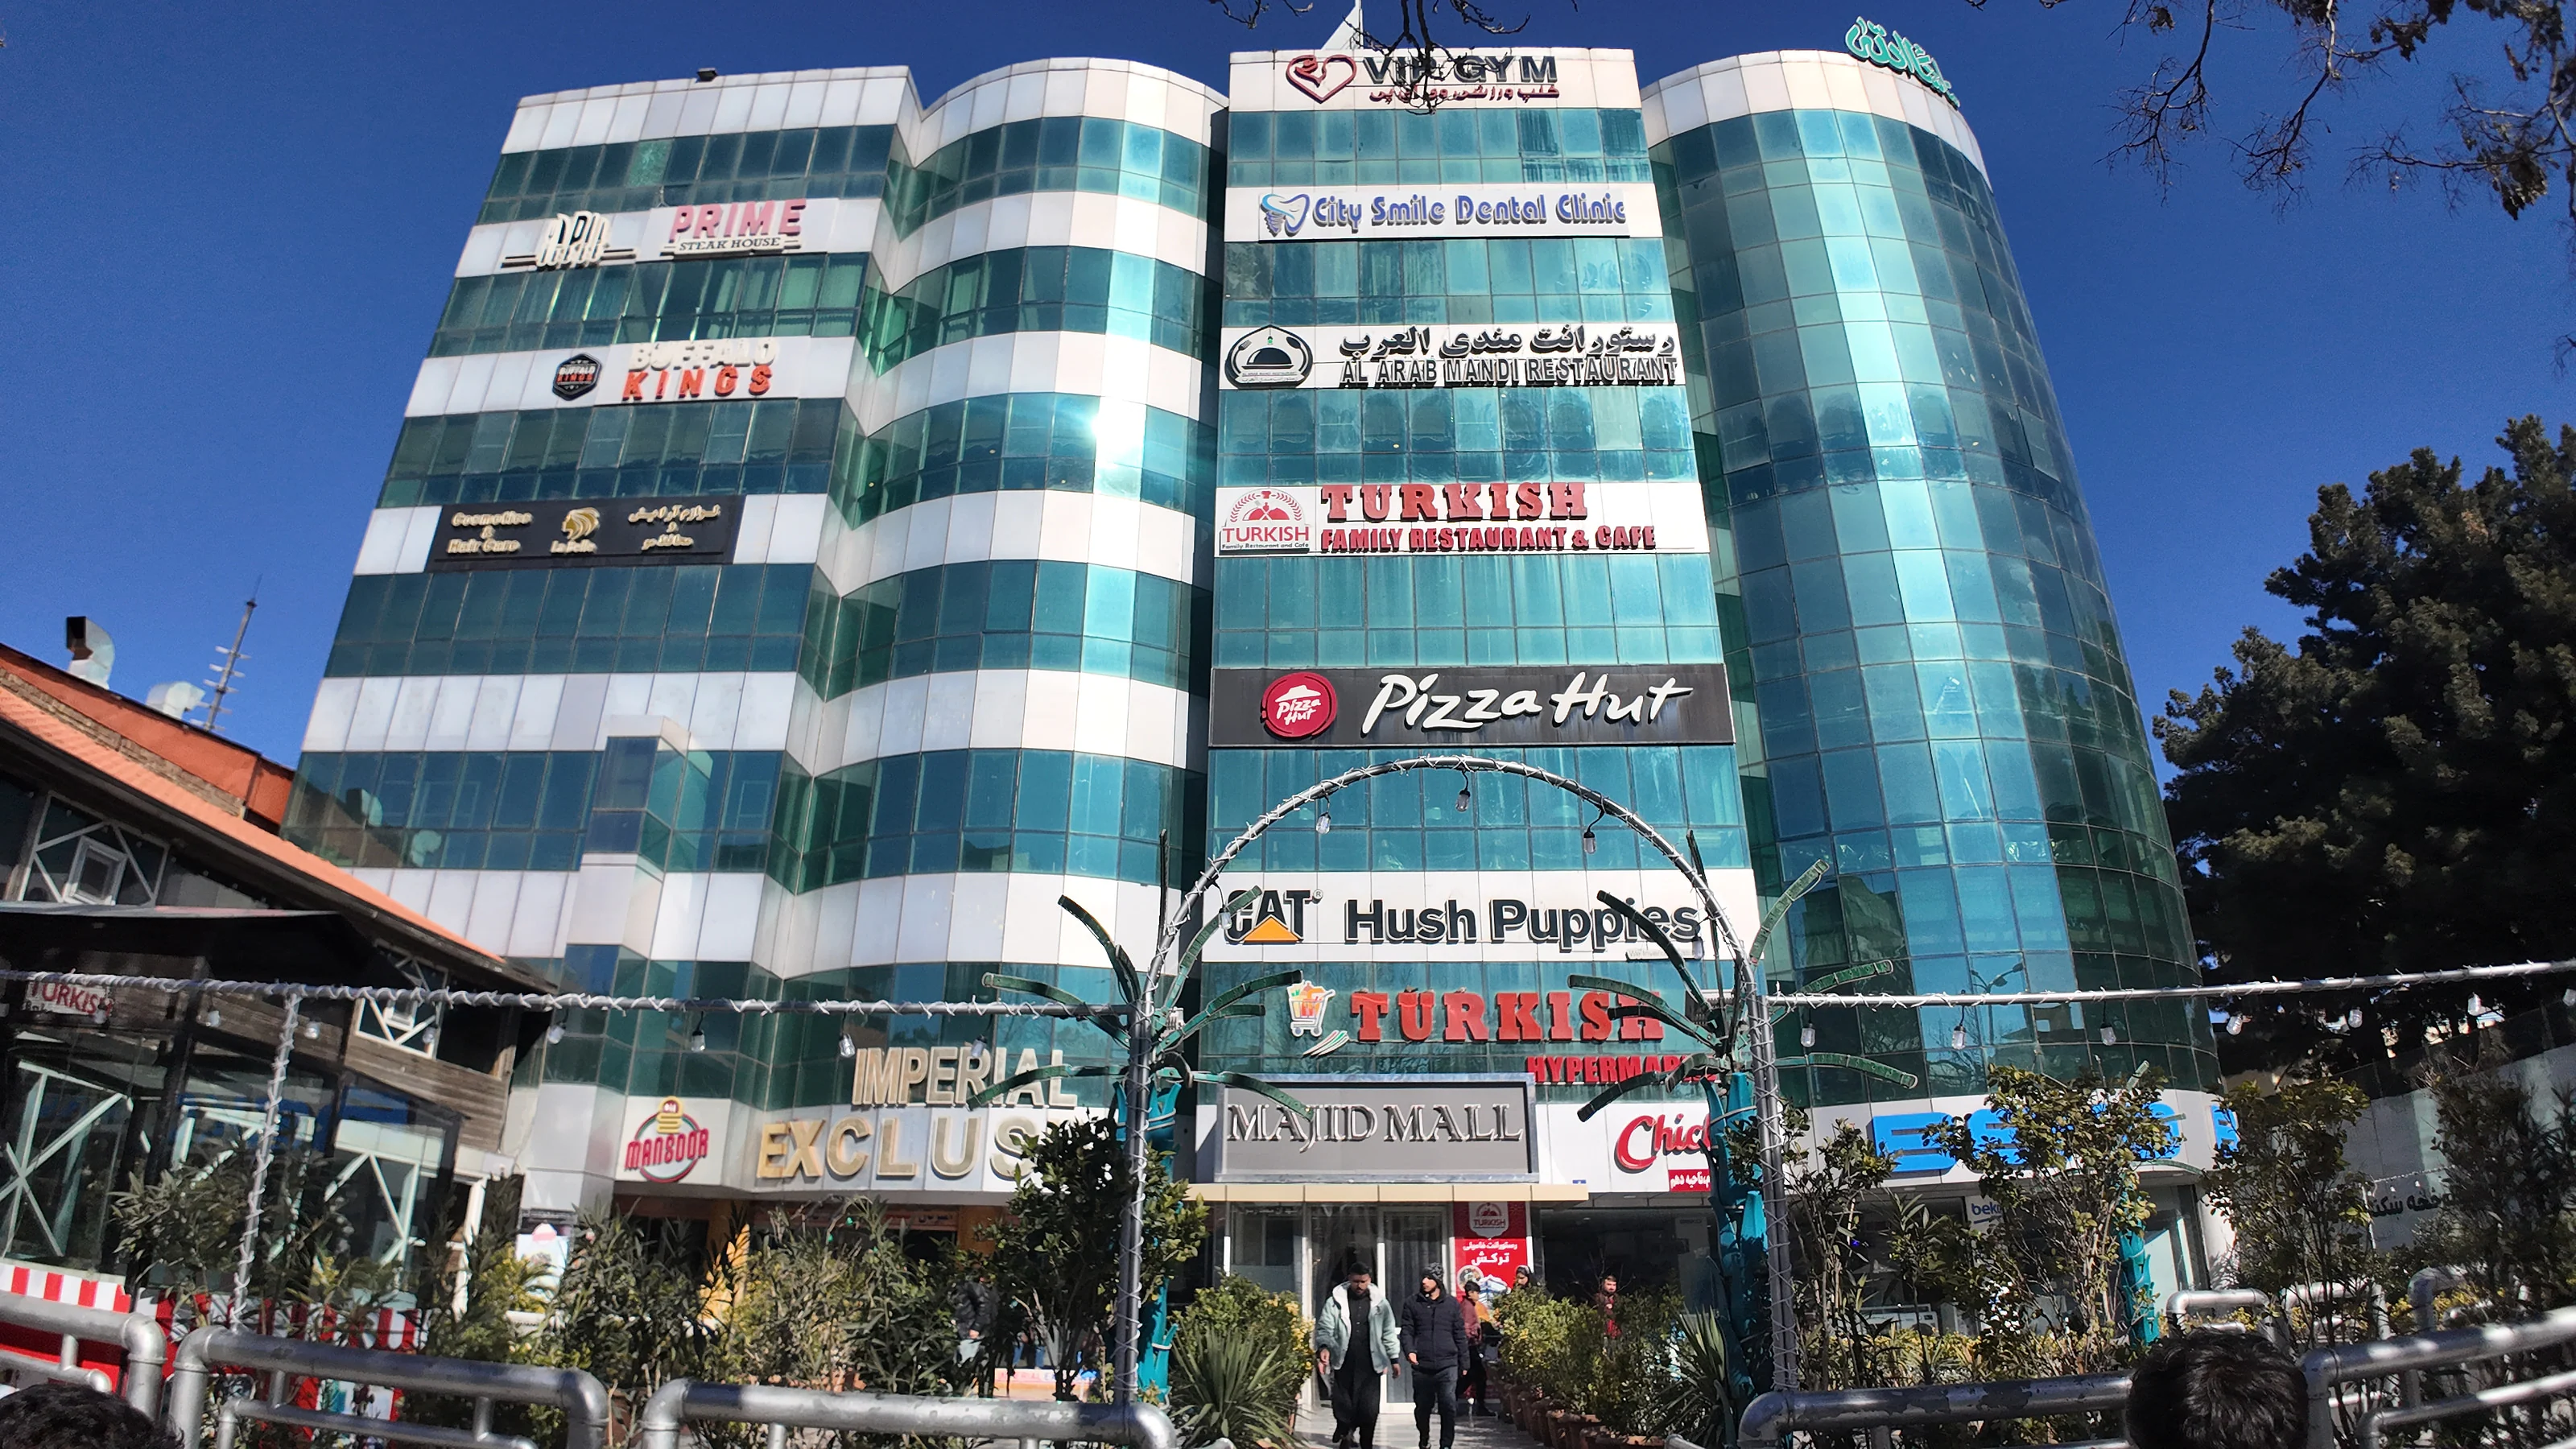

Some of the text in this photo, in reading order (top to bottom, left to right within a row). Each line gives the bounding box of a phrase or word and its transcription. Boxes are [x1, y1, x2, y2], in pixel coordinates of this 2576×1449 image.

[1363, 56, 1558, 84] VIP GYM
[669, 198, 806, 243] PRIME
[1313, 192, 1626, 233] City Smile Dental Clinic
[679, 237, 782, 251] STEAK HOUSE
[1339, 325, 1430, 361] العرب
[622, 364, 773, 401] KINGS
[1339, 357, 1677, 388] AL ARAB MANDI RESTAURANT
[1321, 482, 1587, 522] TURKISH
[1222, 526, 1309, 543] TURKISH
[1321, 525, 1656, 553] FAMILY RESTAURANT & CAFE
[1277, 699, 1321, 719] Pizza
[1284, 708, 1316, 725] Hut
[1361, 671, 1693, 738] Pizza Hut
[1224, 890, 1311, 943] CAT
[1345, 898, 1700, 952] Hush Puppies
[1352, 990, 1664, 1042] TURKISH
[852, 1046, 1078, 1108] IMPERIAL
[1526, 1055, 1717, 1084] HYPERMAR
[757, 1116, 1038, 1180] EXCLUS
[1227, 1104, 1523, 1154] MAJID MALL
[625, 1128, 708, 1171] MANSOOR
